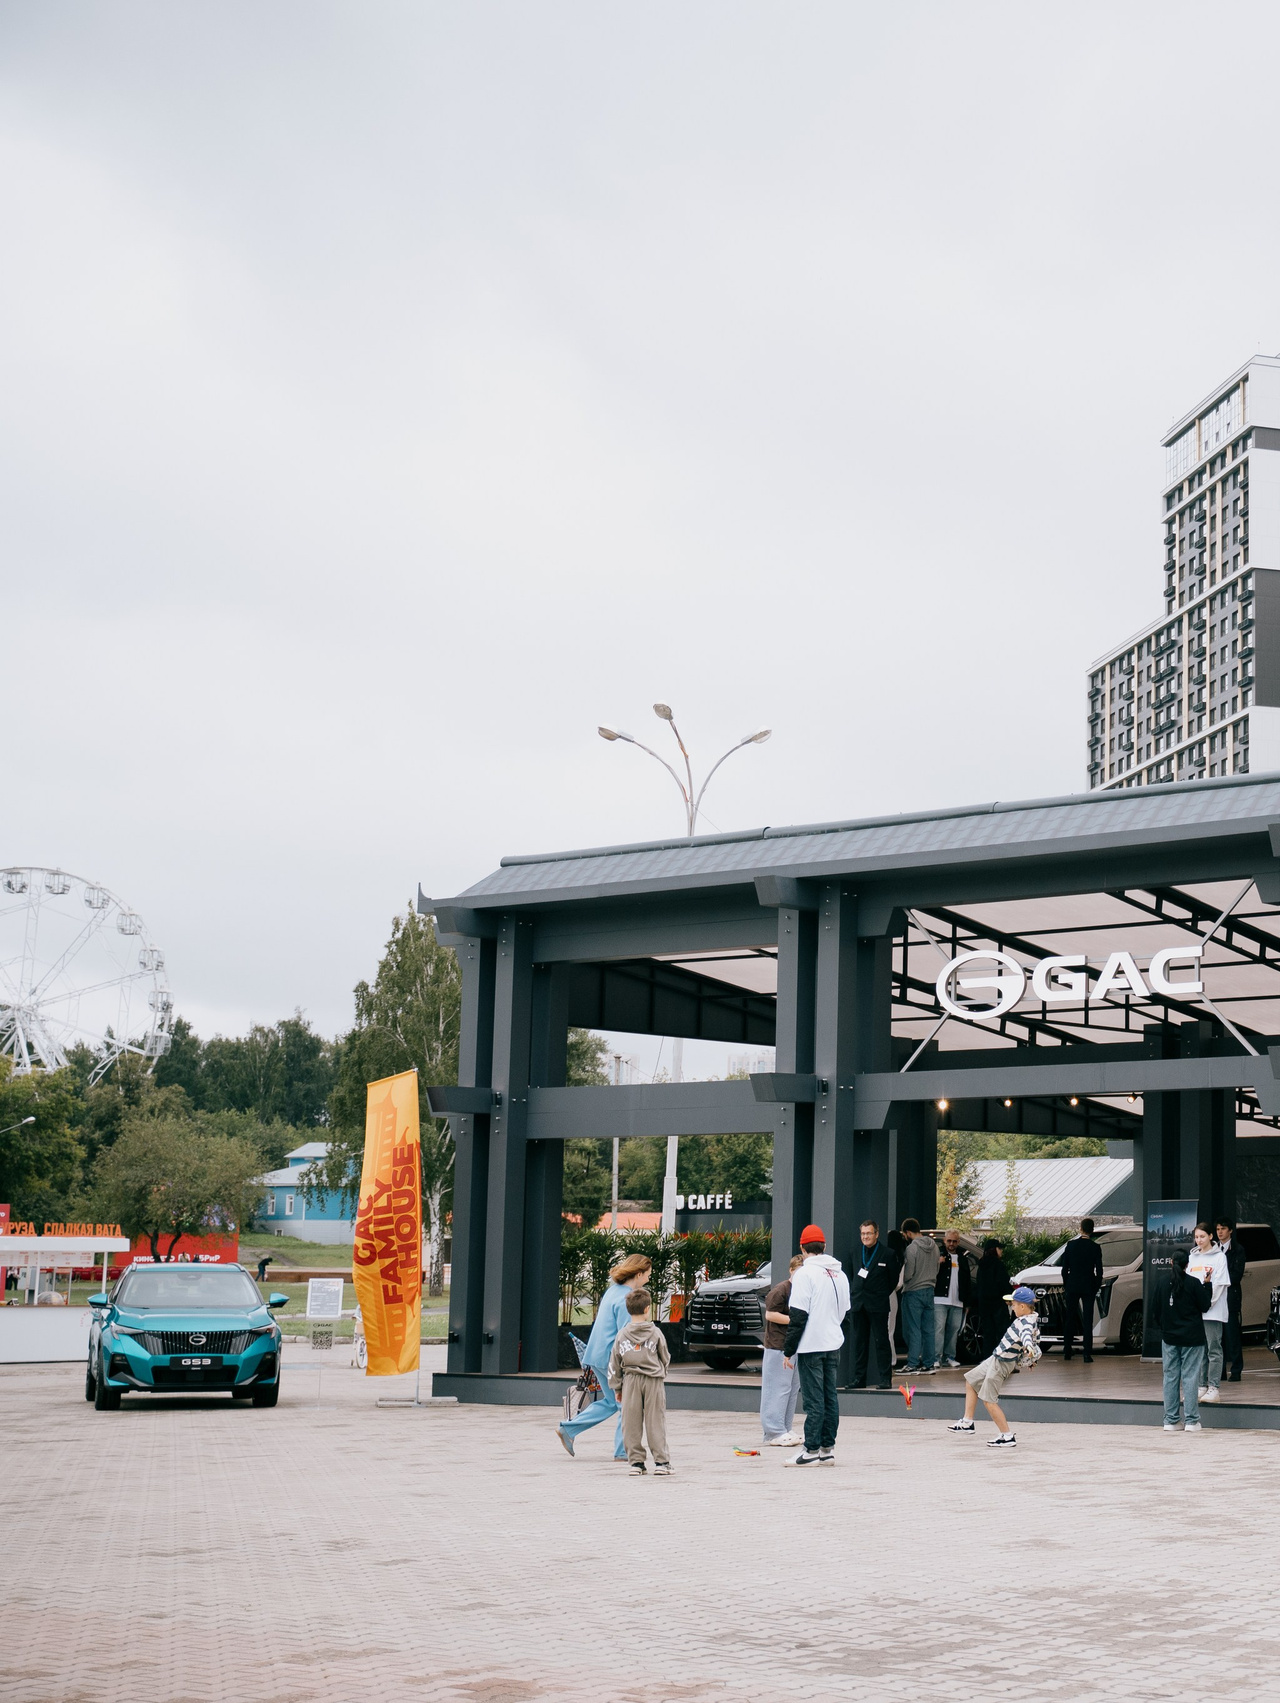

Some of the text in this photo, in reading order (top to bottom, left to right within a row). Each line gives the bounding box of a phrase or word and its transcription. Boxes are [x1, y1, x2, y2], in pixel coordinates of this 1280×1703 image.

[1032, 945, 1205, 1002] GAC
[391, 1143, 418, 1270] HOUSE
[688, 1190, 733, 1210] CAFFÉ
[44, 1222, 94, 1236] СЛАДКАЯ
[96, 1223, 122, 1237] ВАТА
[353, 1193, 378, 1267] GAC
[373, 1177, 404, 1305] FAMILY
[1151, 1257, 1164, 1265] GAC
[181, 1358, 212, 1366] GS3
